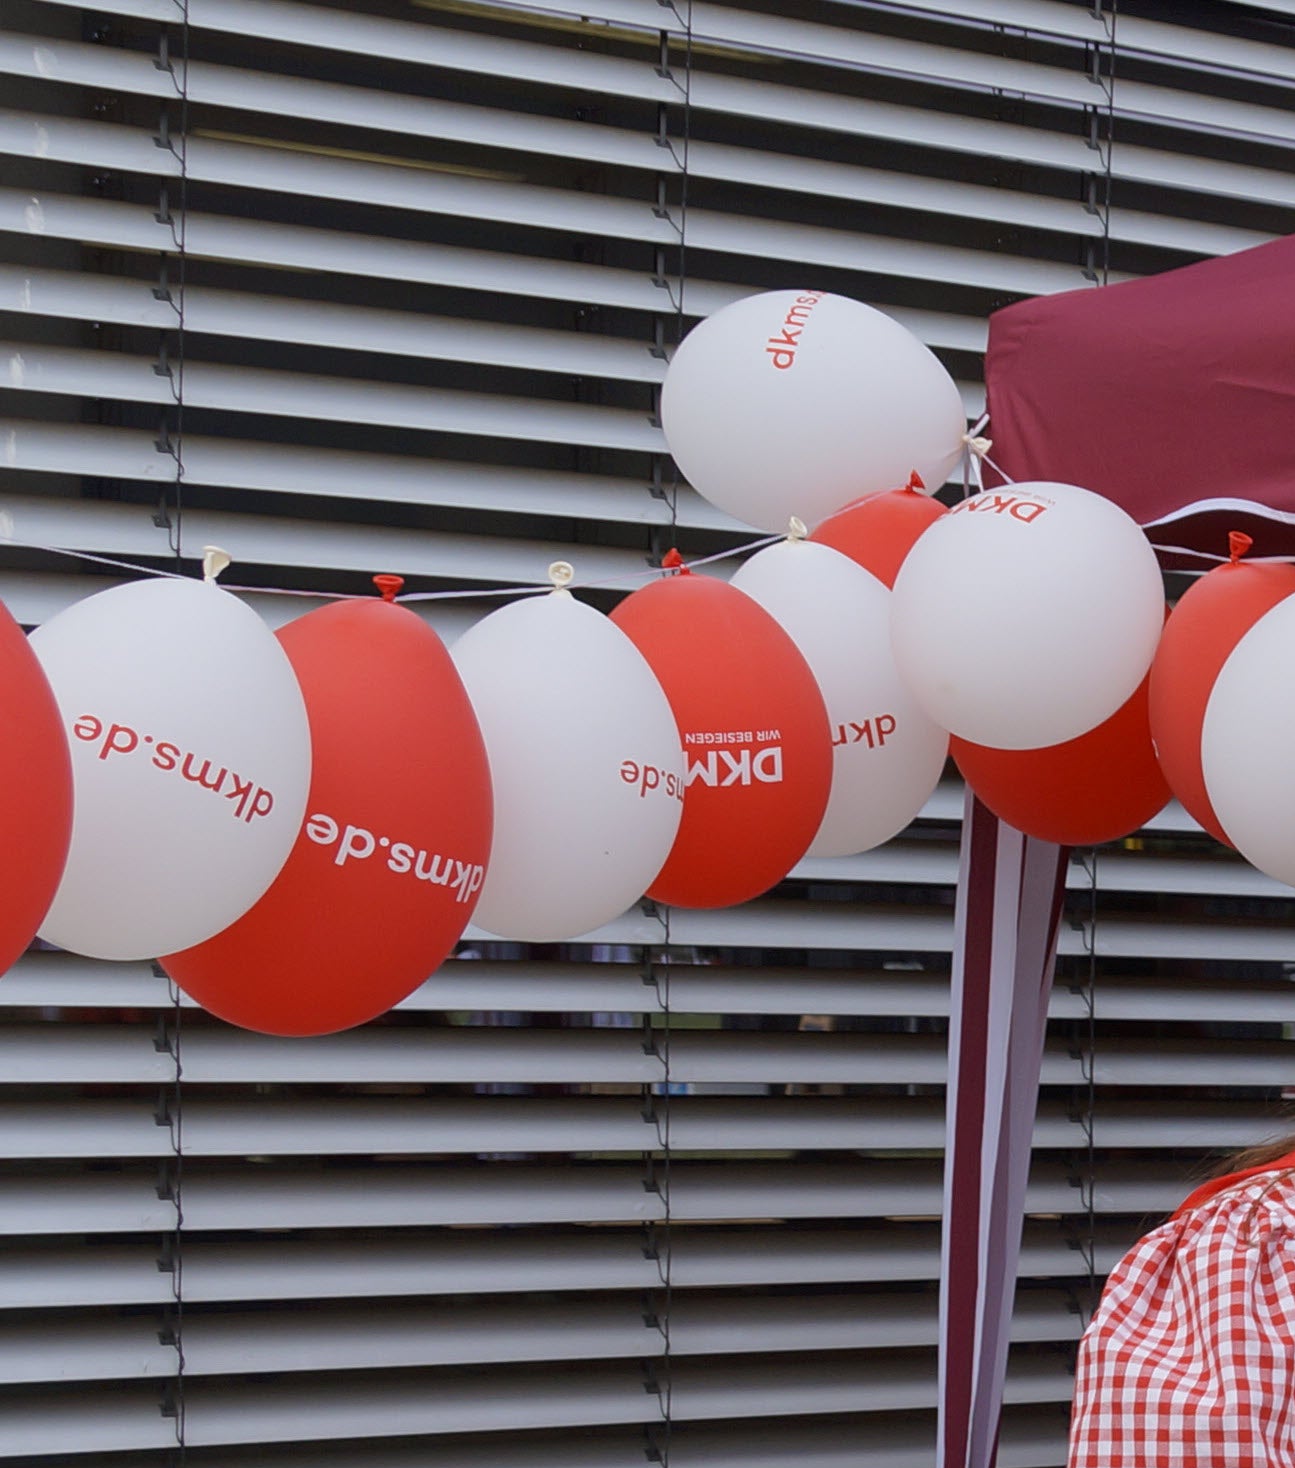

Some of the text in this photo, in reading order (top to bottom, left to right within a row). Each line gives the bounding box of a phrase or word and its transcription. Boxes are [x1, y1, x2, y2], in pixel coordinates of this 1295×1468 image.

[73, 714, 275, 823] dkms.de
[685, 729, 781, 744] WIR BESIEGEN
[305, 813, 484, 903] dkms.de
